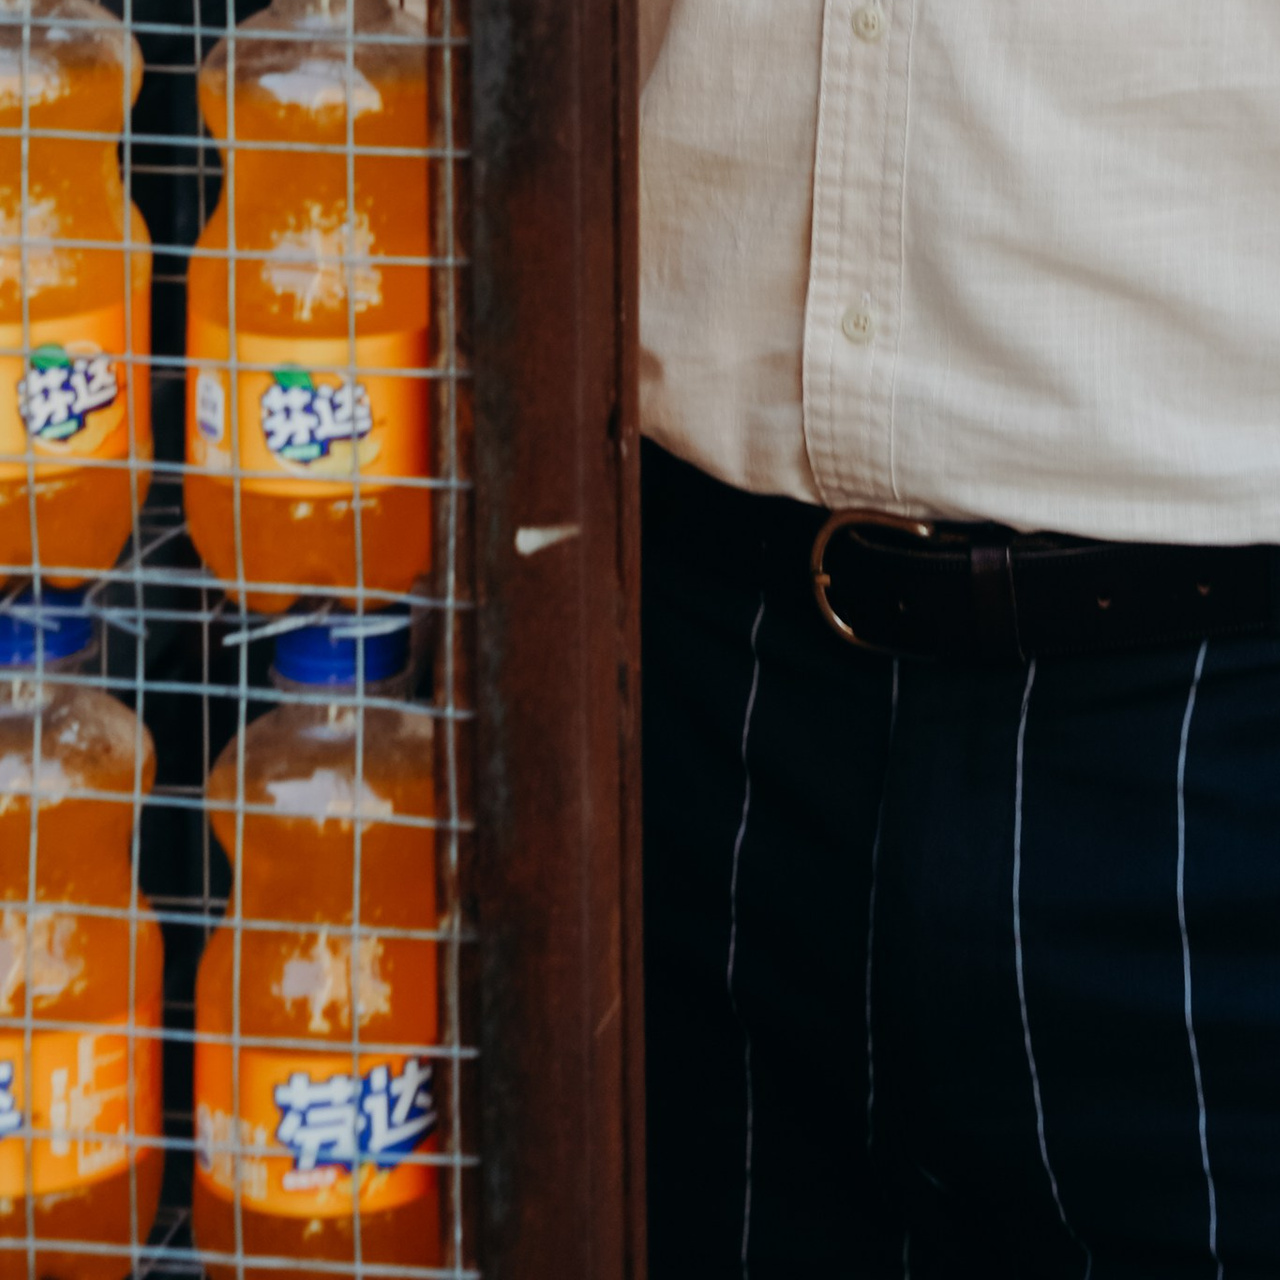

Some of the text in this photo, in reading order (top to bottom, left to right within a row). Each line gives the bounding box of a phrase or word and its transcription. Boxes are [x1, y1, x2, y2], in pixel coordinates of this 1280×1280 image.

[18, 355, 118, 436] 芬达
[261, 382, 372, 452] 芬达
[274, 1059, 438, 1172] 芬达
